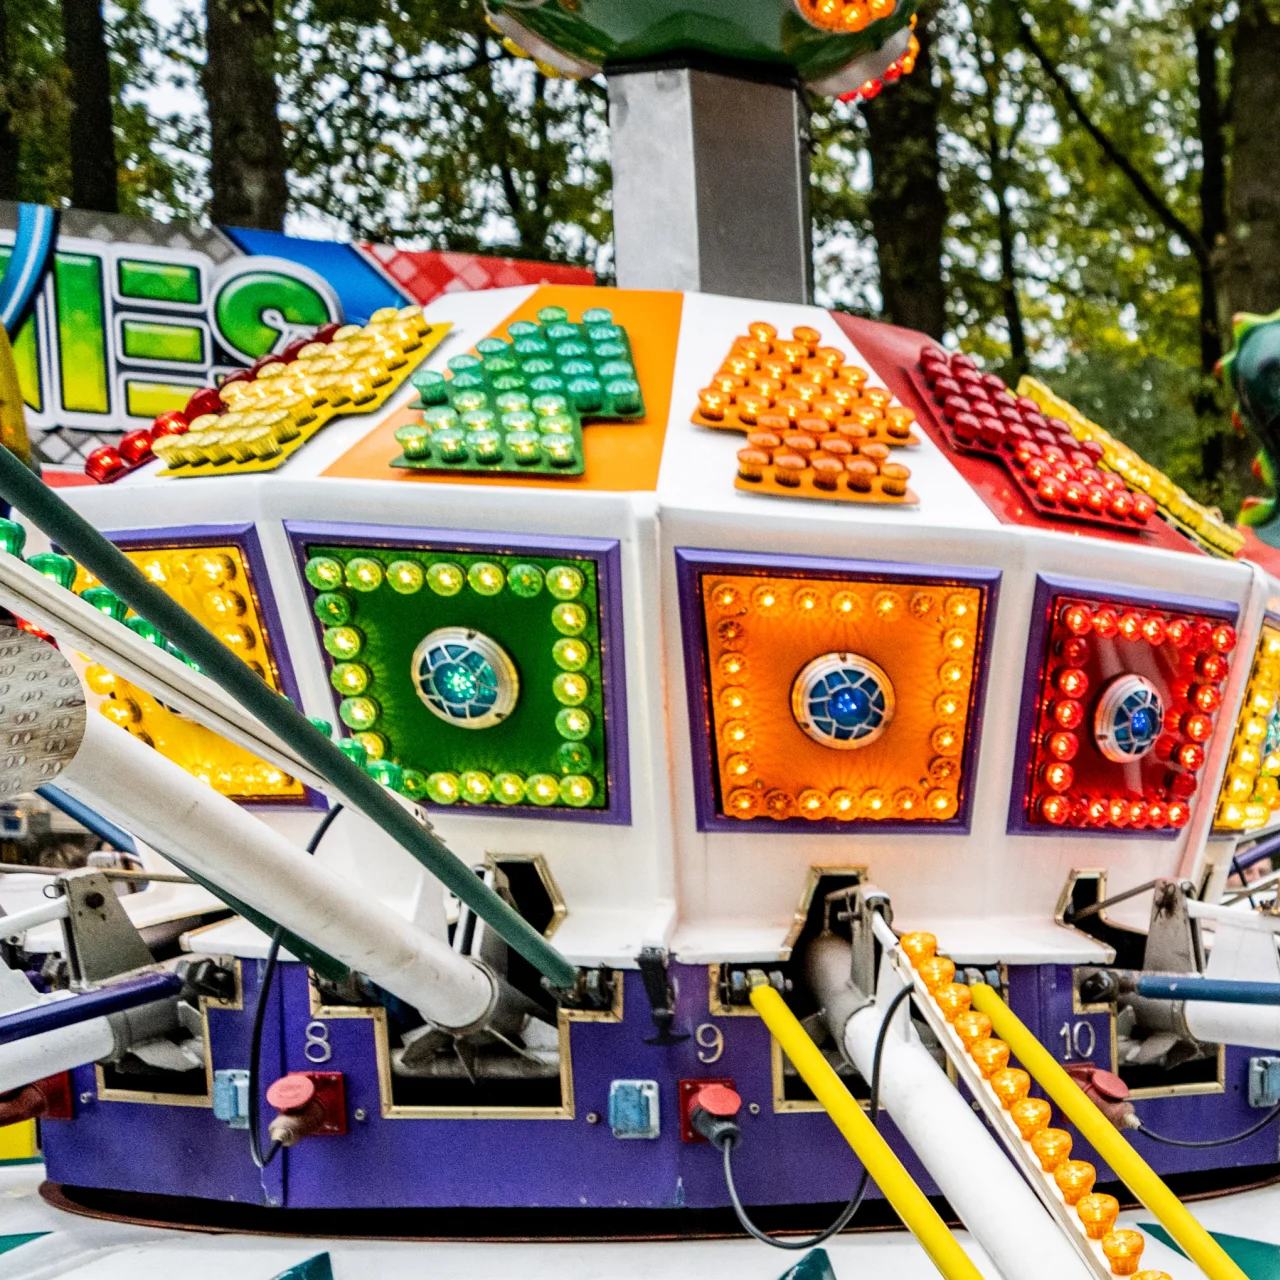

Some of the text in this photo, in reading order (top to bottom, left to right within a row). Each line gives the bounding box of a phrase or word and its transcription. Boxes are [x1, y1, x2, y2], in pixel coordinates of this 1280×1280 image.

[304, 1021, 332, 1063] 8
[695, 1022, 724, 1063] 9
[1059, 1021, 1096, 1060] 10
